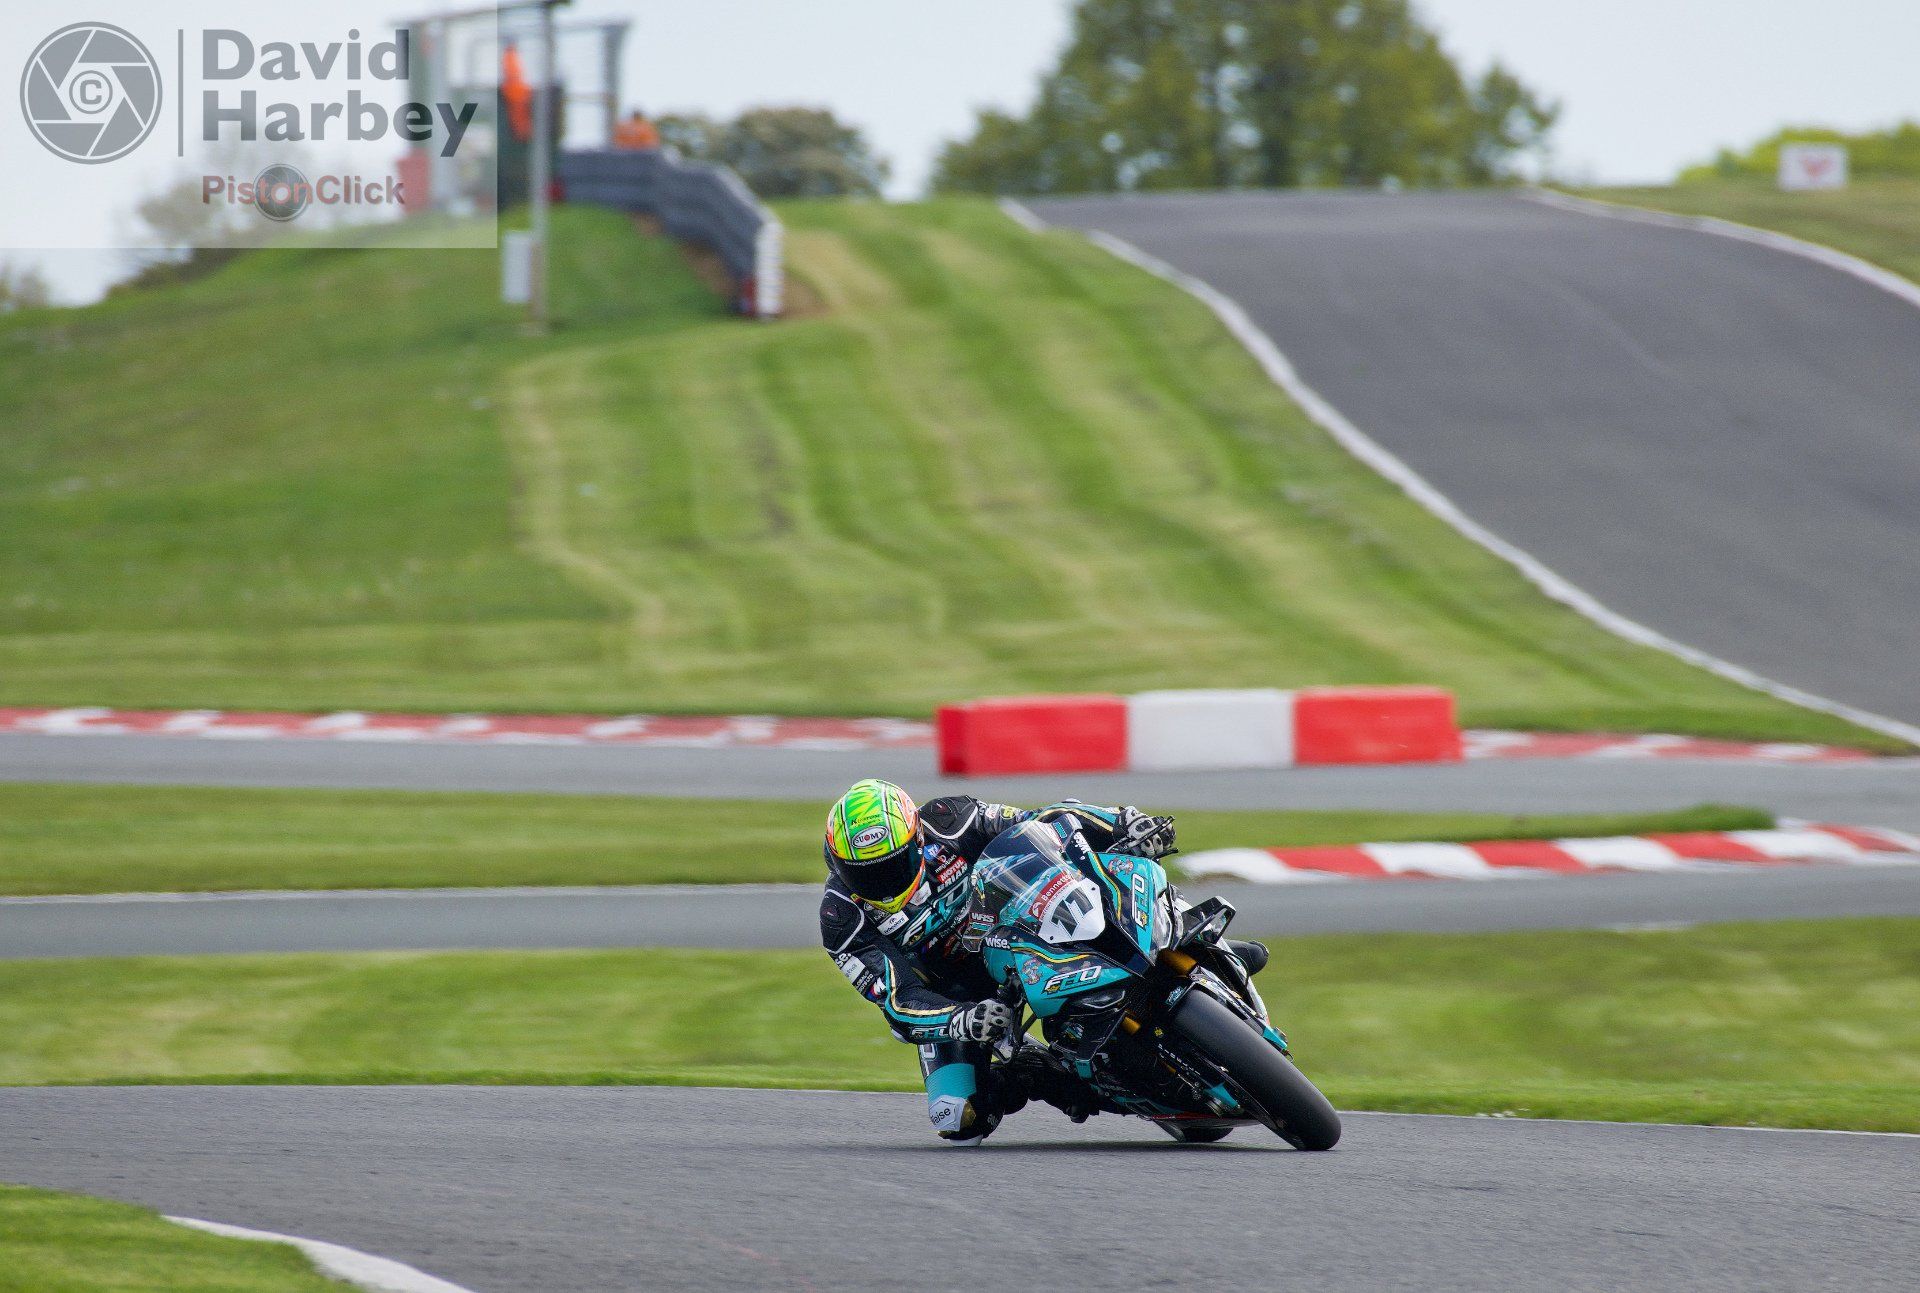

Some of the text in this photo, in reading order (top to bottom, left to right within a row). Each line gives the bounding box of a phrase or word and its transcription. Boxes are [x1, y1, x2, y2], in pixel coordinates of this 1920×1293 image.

[855, 829, 885, 844] SUOMY
[940, 859, 966, 882] MOTUL
[971, 912, 994, 923] WRS
